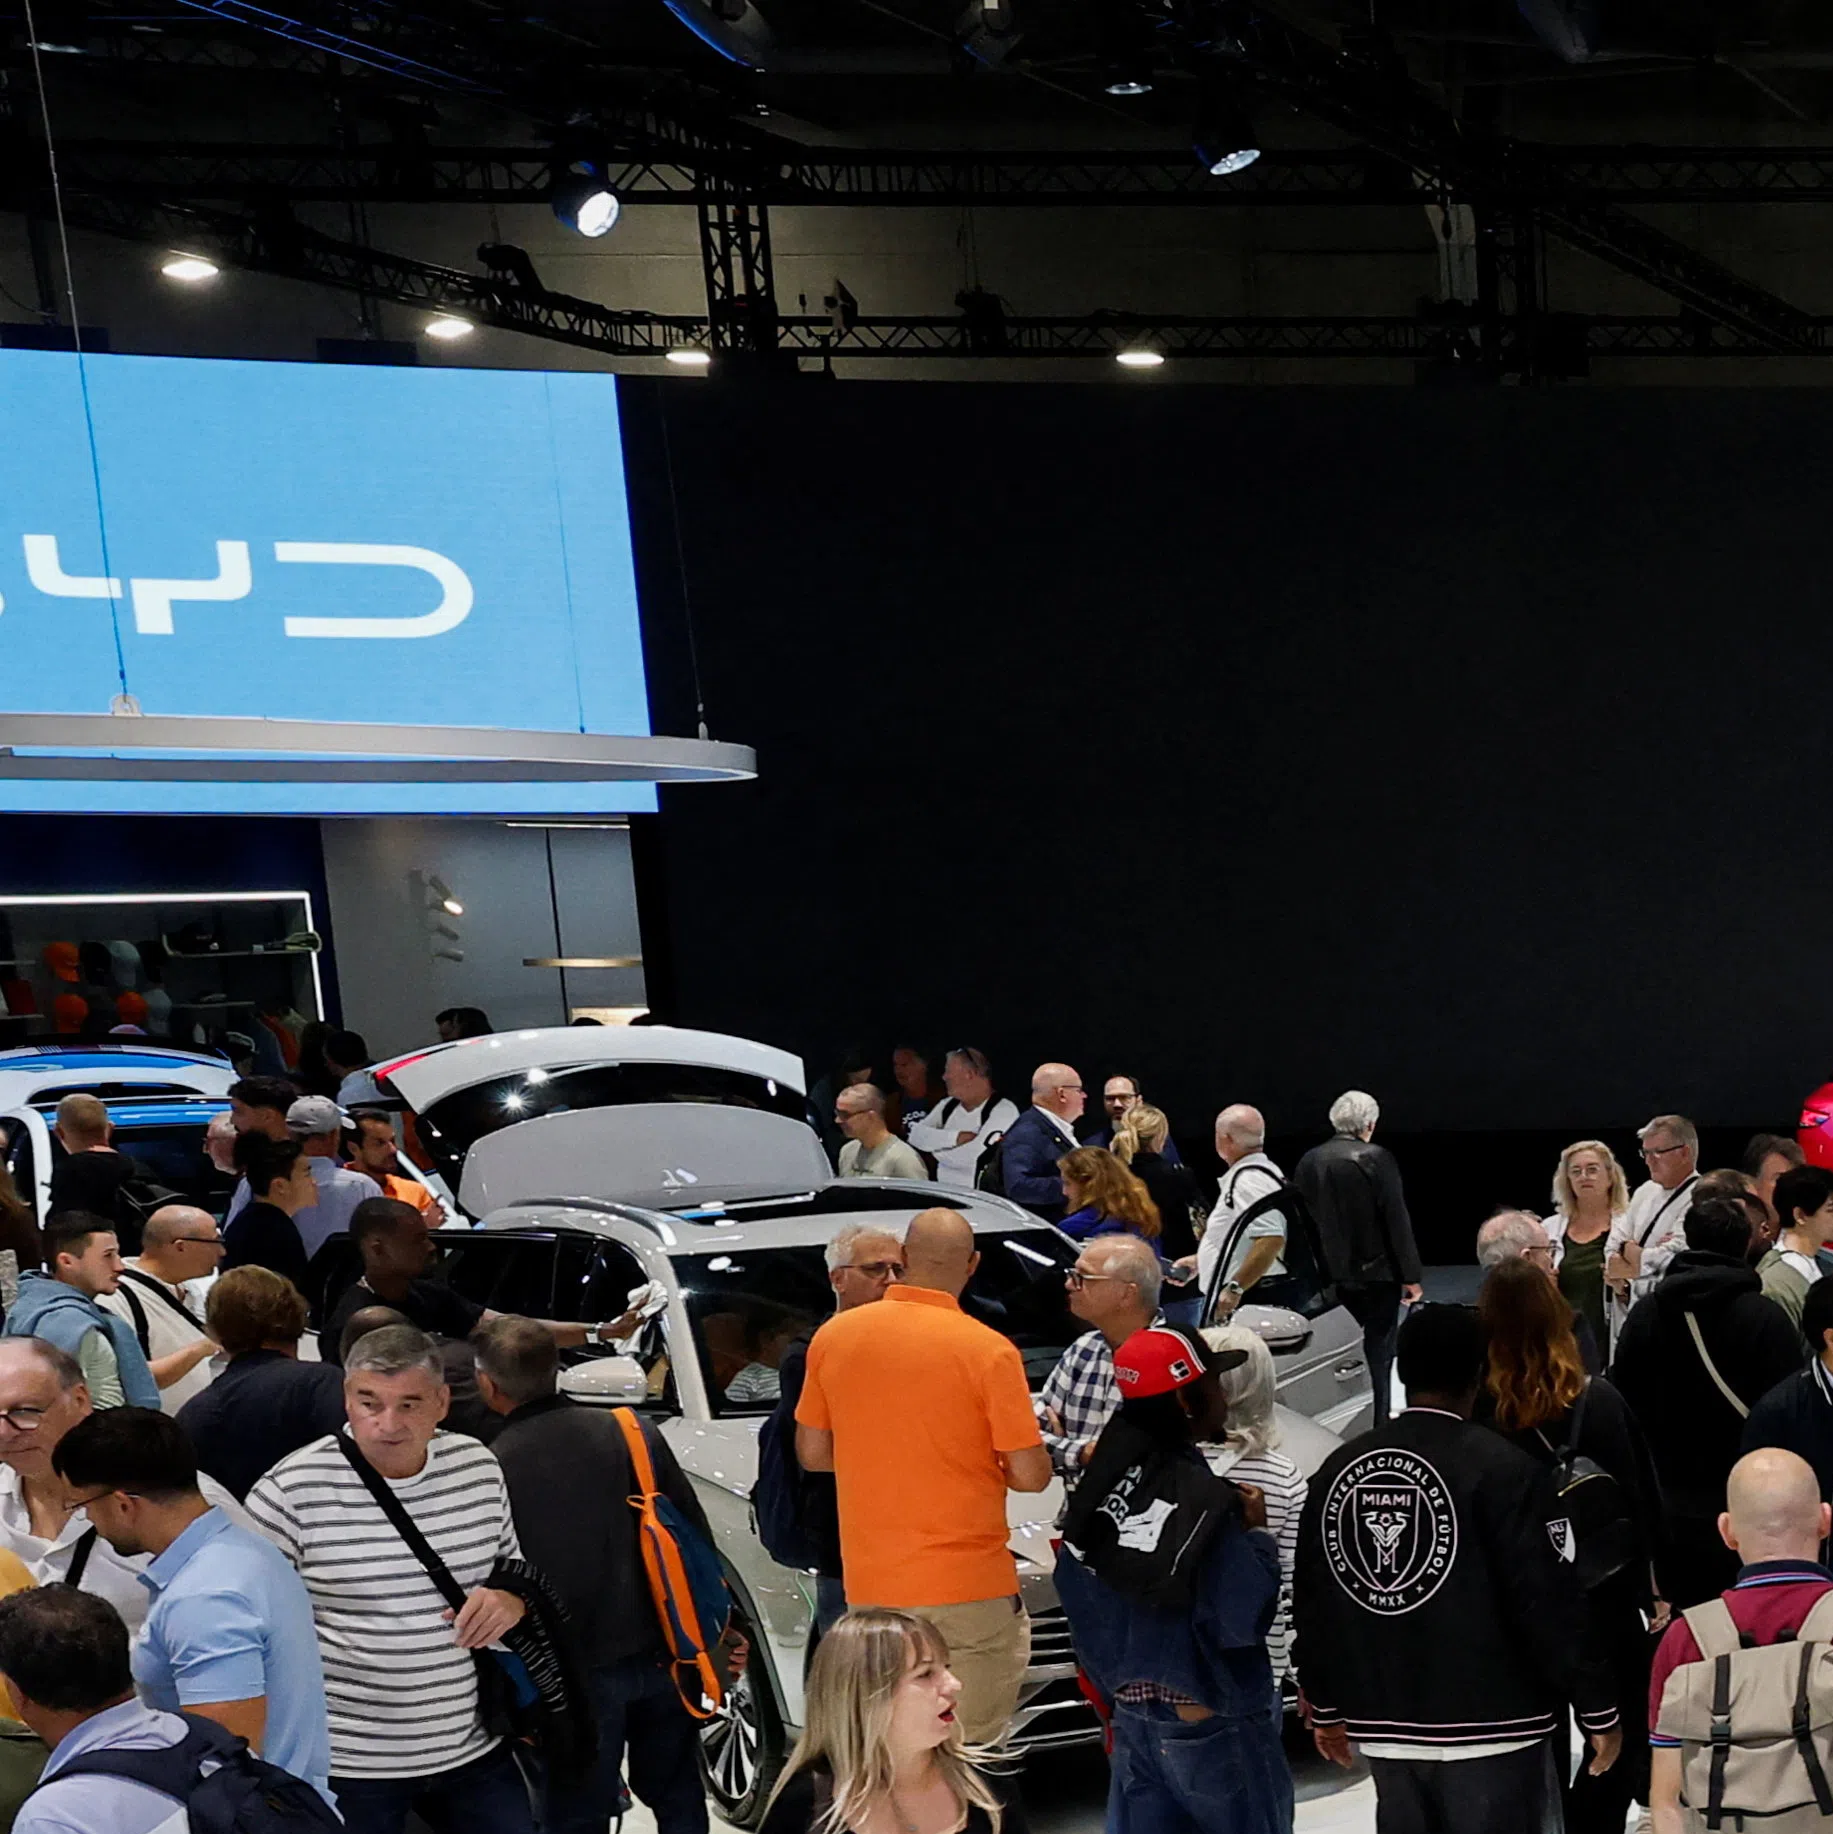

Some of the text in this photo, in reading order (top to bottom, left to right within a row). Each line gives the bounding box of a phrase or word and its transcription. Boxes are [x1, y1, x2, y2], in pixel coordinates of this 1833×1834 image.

[0, 535, 473, 638] YD
[1328, 1456, 1452, 1576] INTERNACIONAL DE FÚTBOL
[1361, 1493, 1412, 1507] MIAMI
[1328, 1529, 1347, 1572] CLUB
[1368, 1592, 1406, 1608] MMXX
